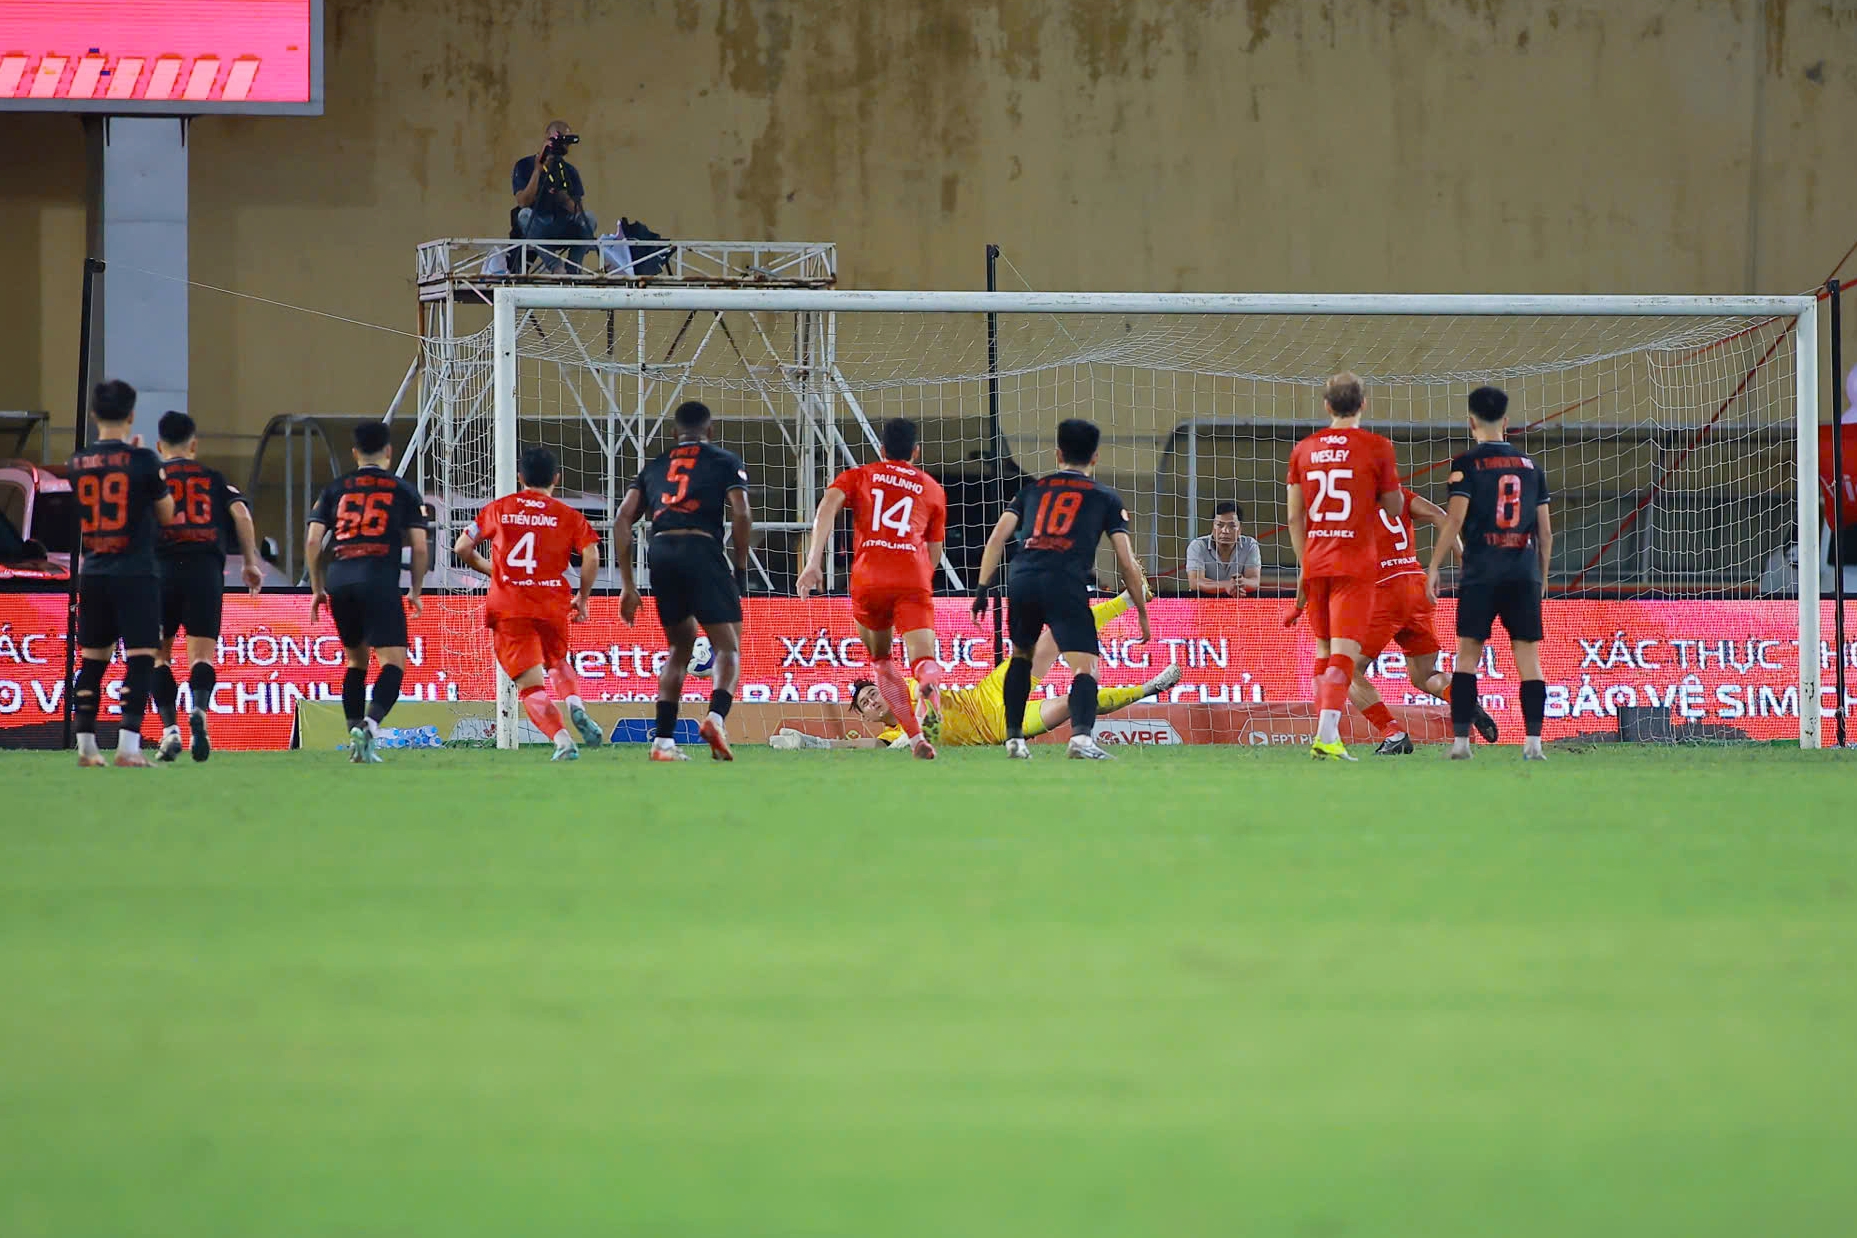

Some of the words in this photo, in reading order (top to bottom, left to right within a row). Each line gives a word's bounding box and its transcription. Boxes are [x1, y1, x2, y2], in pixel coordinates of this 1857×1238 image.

[1310, 449, 1350, 464] WESLEY
[77, 472, 130, 532] 99
[167, 476, 212, 525] 26
[661, 457, 697, 504] 5
[872, 473, 923, 495] PAULINHO
[1306, 469, 1353, 522] 25
[1496, 473, 1521, 529] 8
[871, 488, 914, 537] 14
[1033, 491, 1083, 537] 18
[1379, 508, 1408, 551] 9
[506, 531, 537, 575] 4
[216, 626, 343, 666] HÔNG
[779, 628, 866, 668] XÁC
[1160, 638, 1229, 669] TIN
[1579, 630, 1660, 669] XÁC
[1670, 637, 1783, 675] THỰC
[1545, 674, 1637, 718] BẢO
[1643, 673, 1706, 723] VỆ
[1716, 685, 1798, 718] SIM
[1120, 731, 1168, 745] VPF
[1271, 734, 1296, 745] FPT
